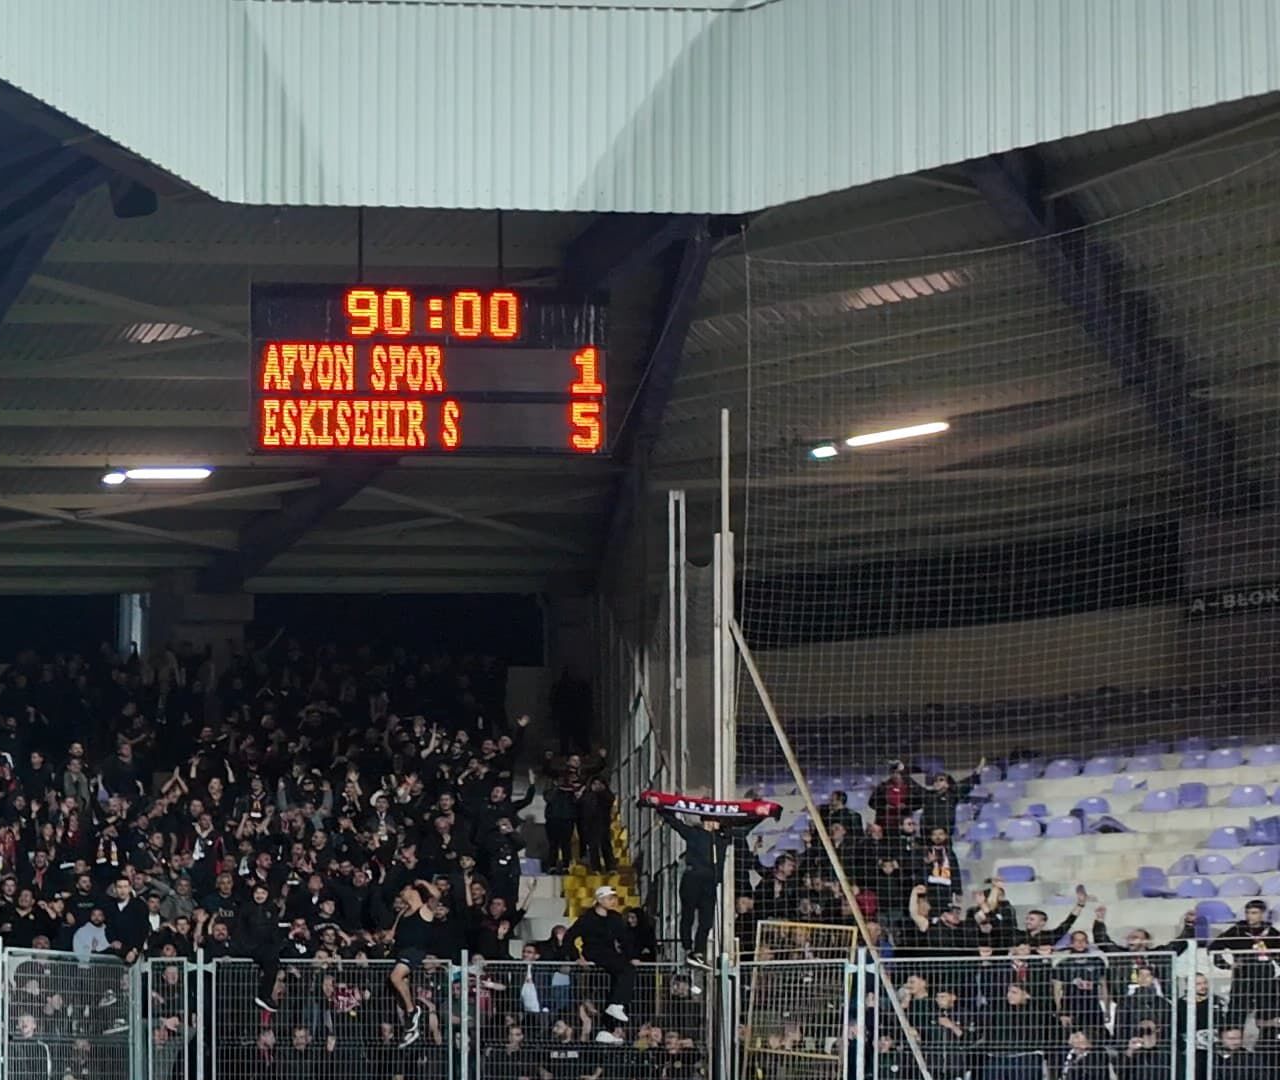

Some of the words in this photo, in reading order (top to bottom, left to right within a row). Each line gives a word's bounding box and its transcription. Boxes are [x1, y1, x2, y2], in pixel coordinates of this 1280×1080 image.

[263, 344, 354, 391] AFYON
[370, 345, 443, 392] SPOR
[572, 347, 603, 394] 1
[263, 399, 425, 447] ESKISEHIR
[443, 400, 459, 447] S
[571, 402, 600, 449] 5
